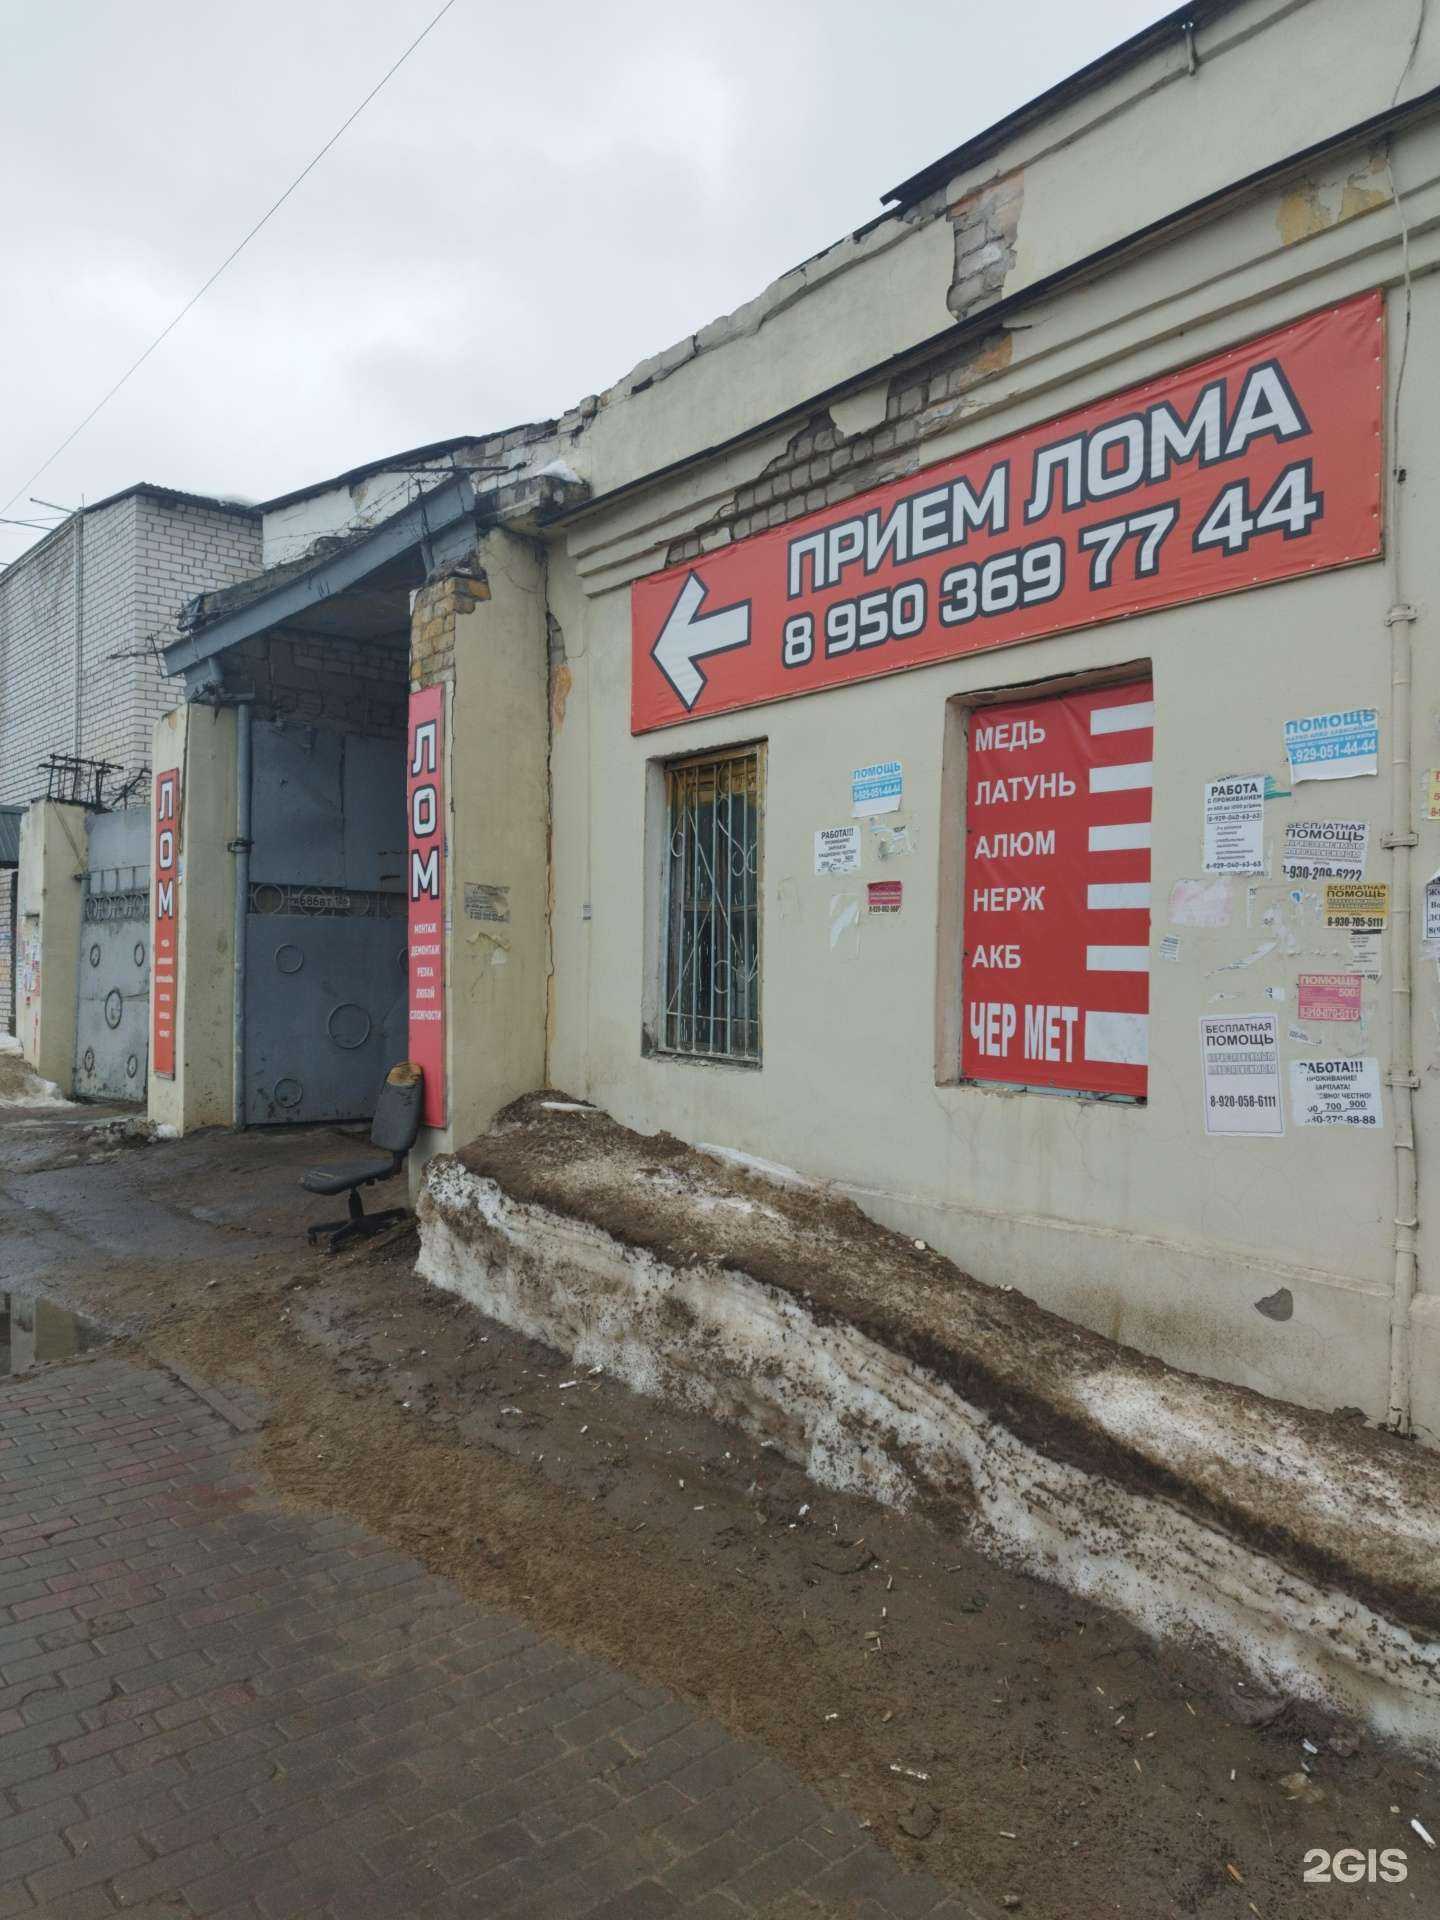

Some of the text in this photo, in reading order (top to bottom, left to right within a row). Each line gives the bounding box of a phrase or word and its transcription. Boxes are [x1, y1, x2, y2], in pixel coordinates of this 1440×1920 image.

[787, 357, 1312, 601] ПРИЕМ ЛОМА
[782, 457, 1324, 669] 8 950 369 77 44
[1286, 709, 1376, 735] ПОМОЩЬ
[975, 719, 1046, 752] МЕДЬ
[1290, 738, 1377, 764] -929-051-44-44
[853, 762, 901, 779] ПОМОЩЬ
[974, 771, 1077, 806] ЛАТУНЬ
[1211, 782, 1258, 797] РАБОТА
[411, 719, 439, 901] ЛОМ
[974, 829, 1056, 860] АЛЮМ
[1285, 829, 1365, 842] ПОМОЩЬ
[157, 779, 174, 920] ЛОМ
[973, 886, 1046, 912] НЕРЖ
[1327, 890, 1386, 898] ПОМОЩЬ
[972, 944, 1022, 969] АКБ
[1300, 975, 1360, 987] ПОМОЩЬ
[970, 1002, 1079, 1063] ЧЕР МЕТ
[1206, 1022, 1272, 1033] БЕСПЛАТНАЯ
[1207, 1033, 1274, 1046] ПОМОЩЬ
